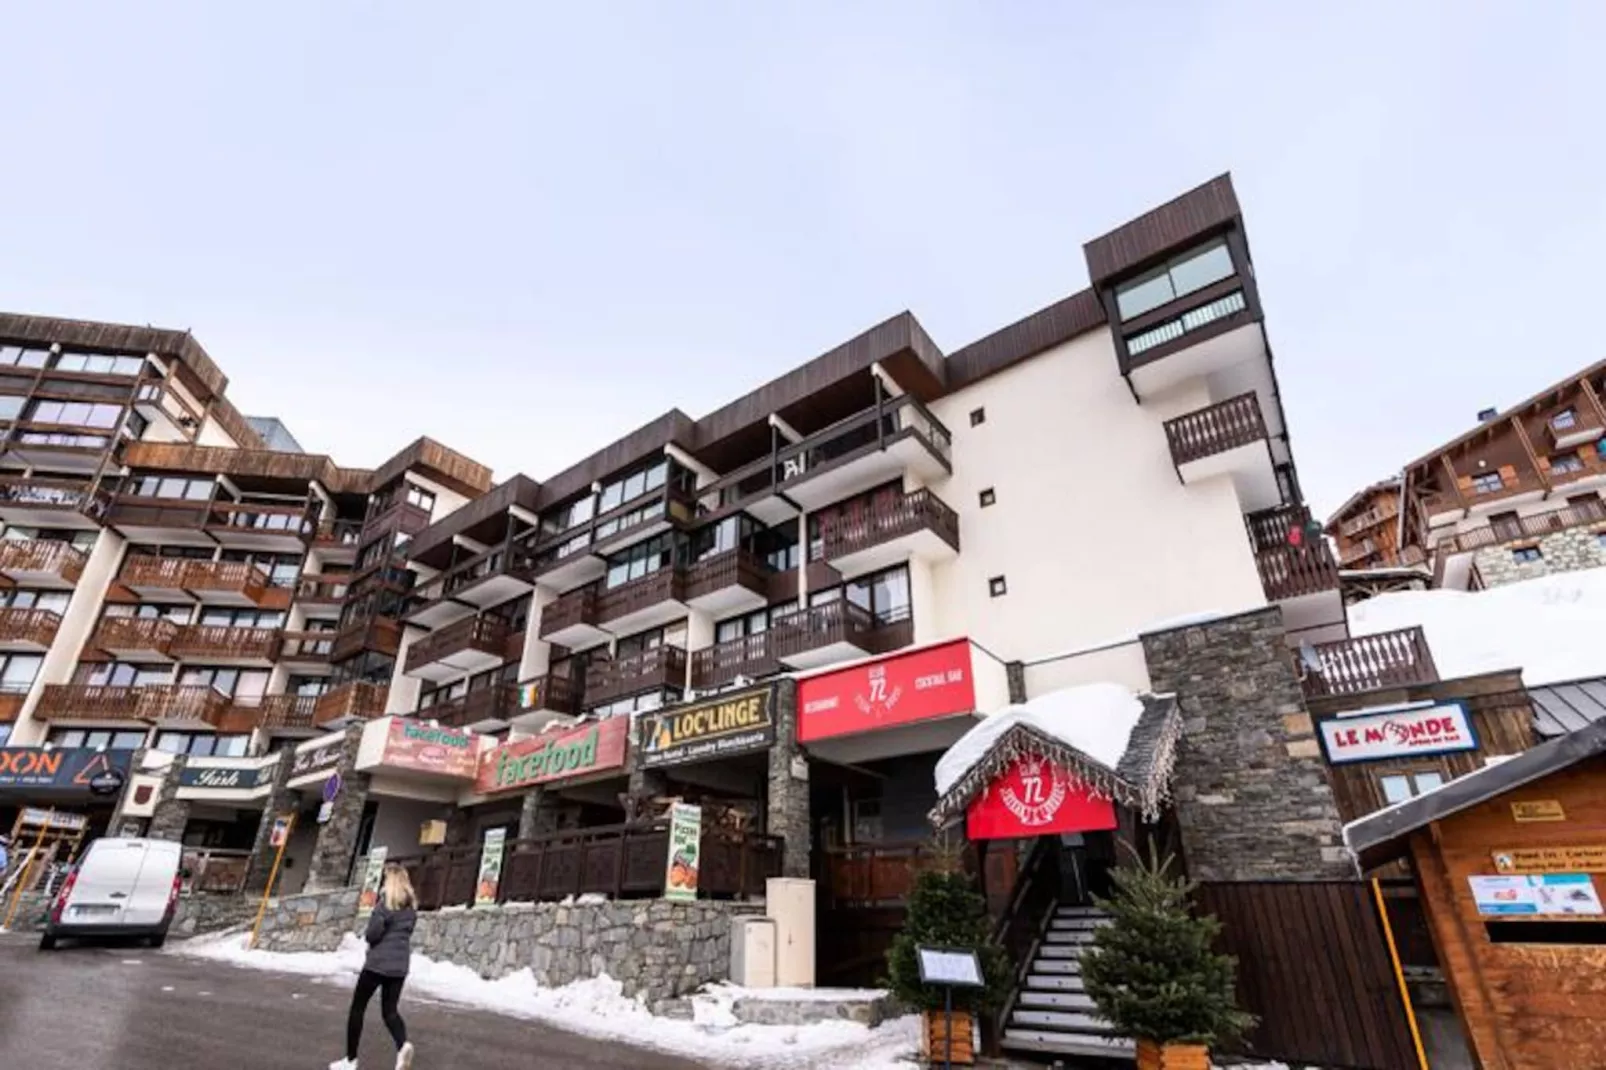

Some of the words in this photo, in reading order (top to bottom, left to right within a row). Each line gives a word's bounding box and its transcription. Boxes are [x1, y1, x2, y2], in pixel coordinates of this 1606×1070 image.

[869, 679, 888, 703] 72
[672, 697, 761, 739] LOC'LINGE
[1334, 729, 1359, 747] LE
[496, 728, 599, 785] facefood
[1021, 776, 1045, 804] 72
